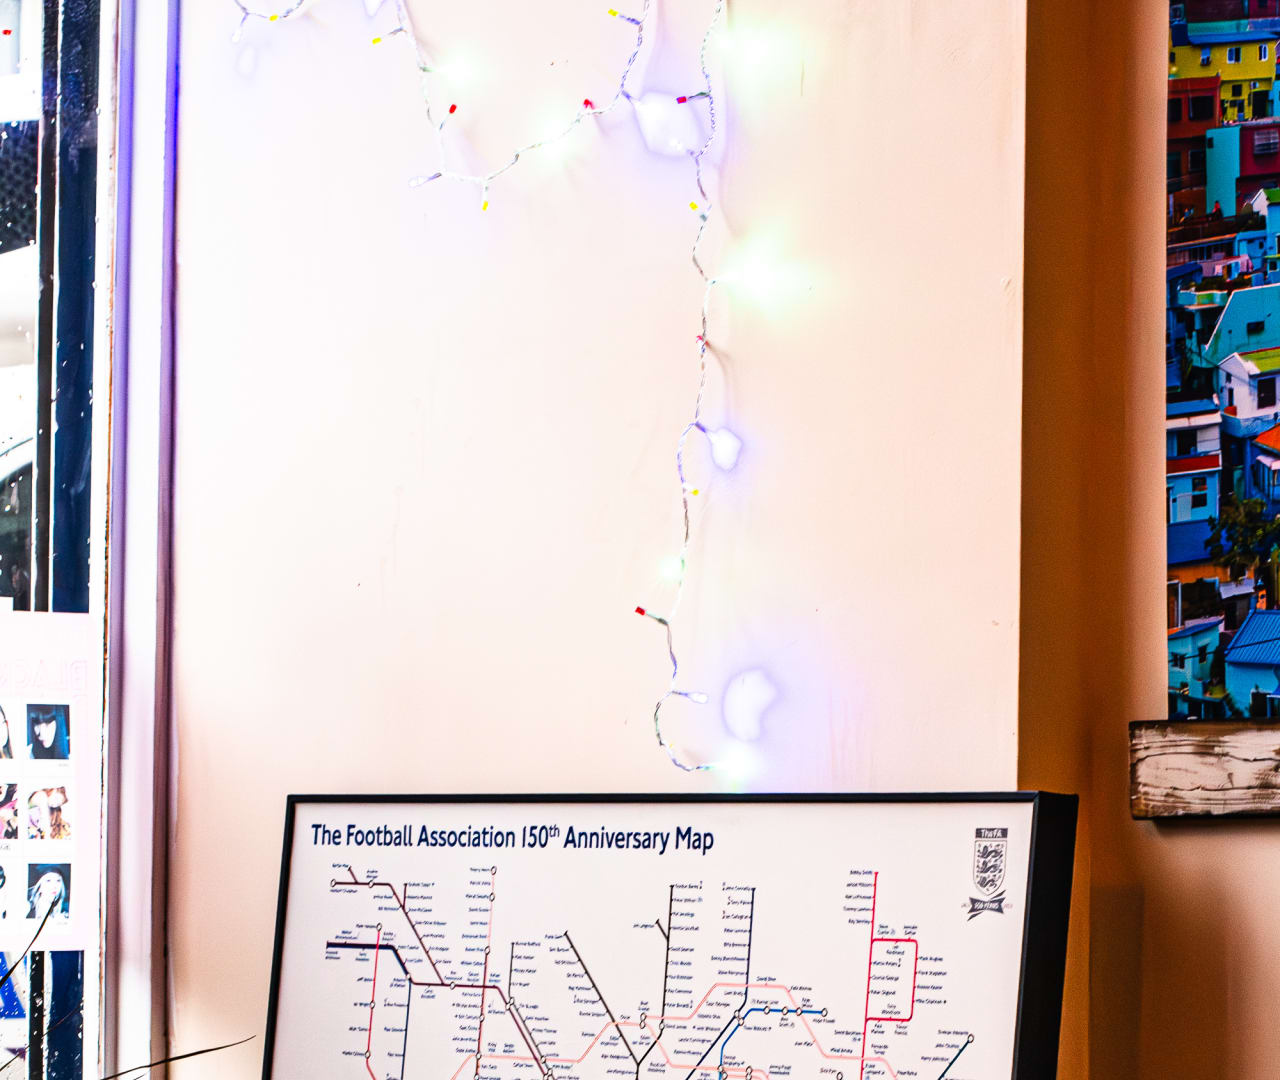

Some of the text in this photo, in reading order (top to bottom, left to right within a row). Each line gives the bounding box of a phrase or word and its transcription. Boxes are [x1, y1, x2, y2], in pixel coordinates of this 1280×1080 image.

[312, 824, 714, 856] The Football Association 150th Anniversary Map
